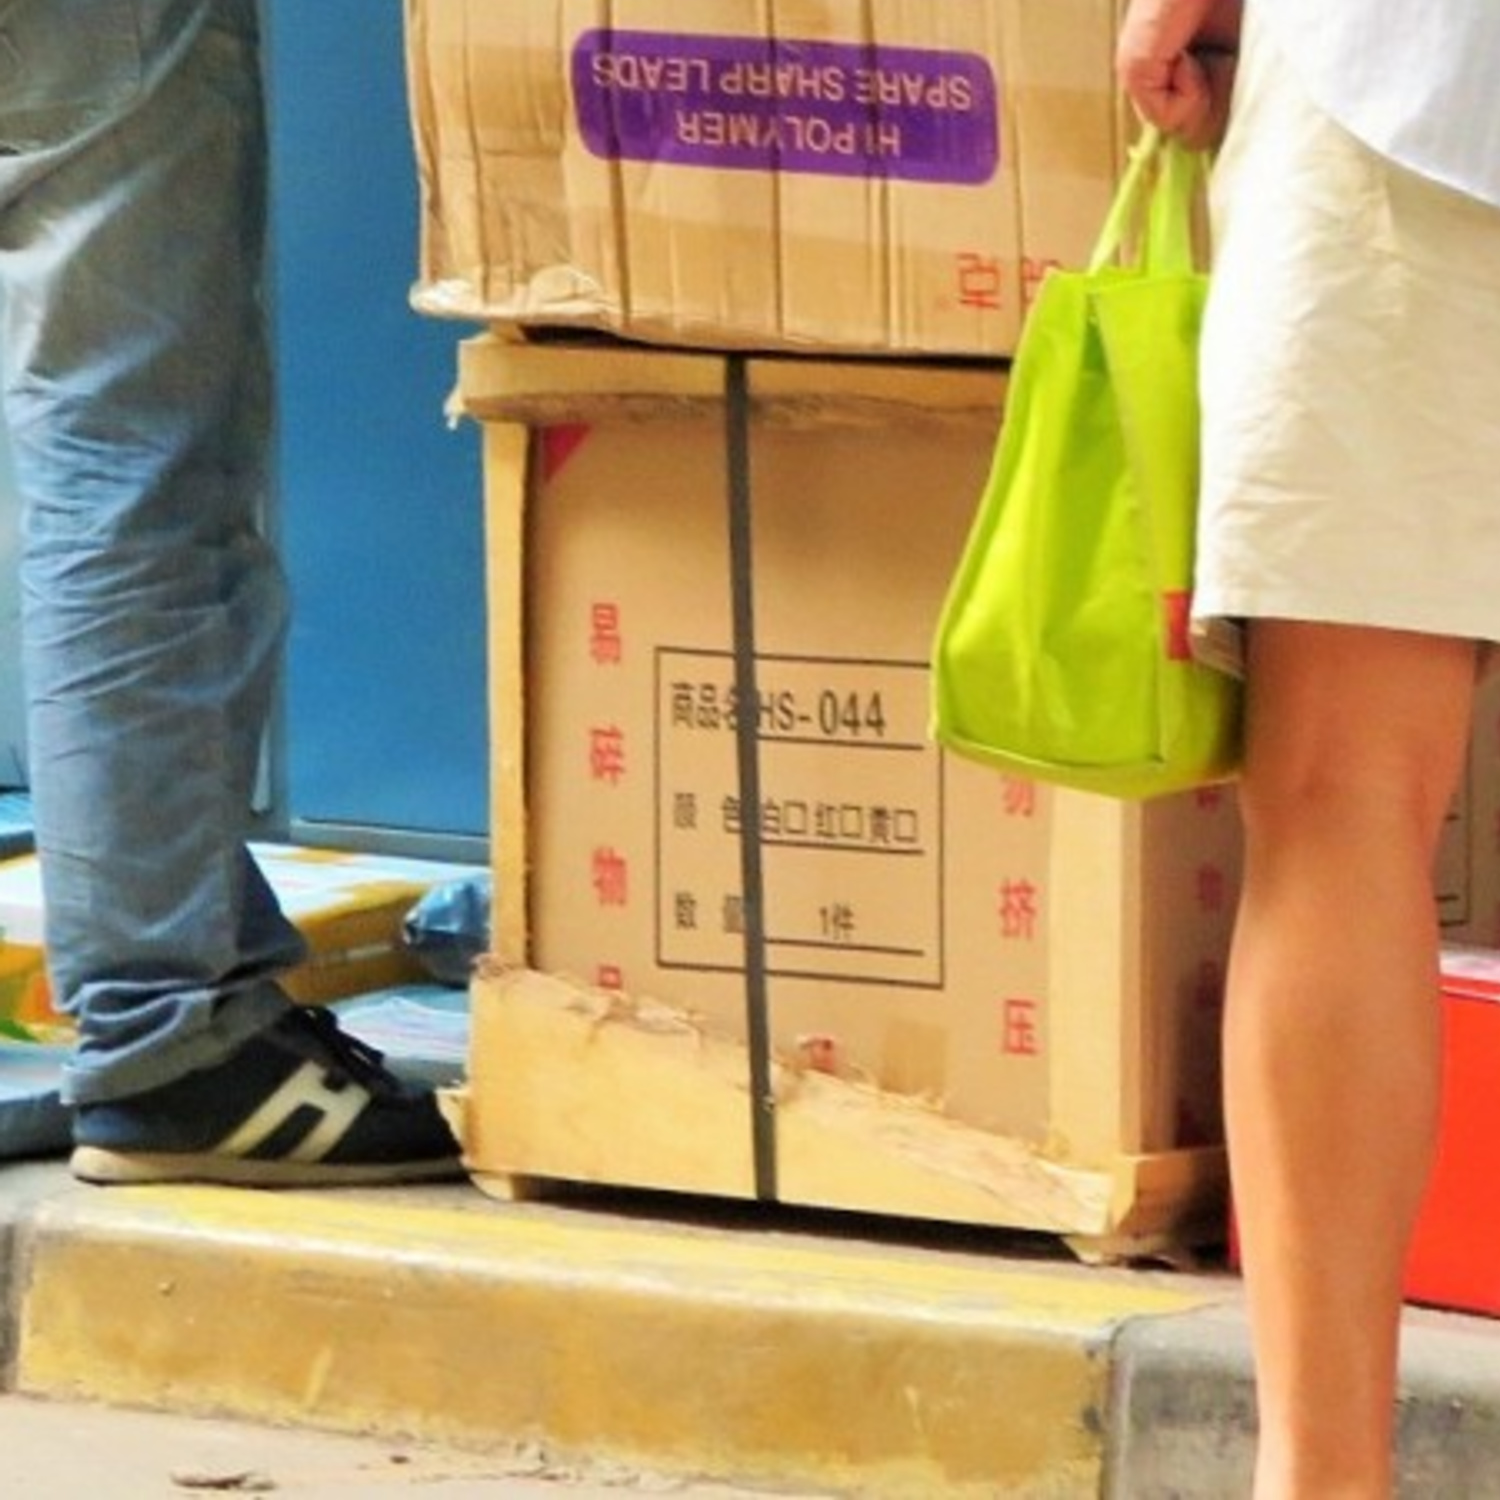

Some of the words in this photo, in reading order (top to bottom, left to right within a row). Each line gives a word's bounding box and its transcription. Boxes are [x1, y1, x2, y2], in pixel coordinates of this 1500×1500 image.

[591, 53, 709, 92] LEADS
[720, 60, 844, 101] SHARP
[856, 67, 972, 111] SPARE
[677, 110, 855, 154] POLYMER
[866, 123, 900, 156] HI
